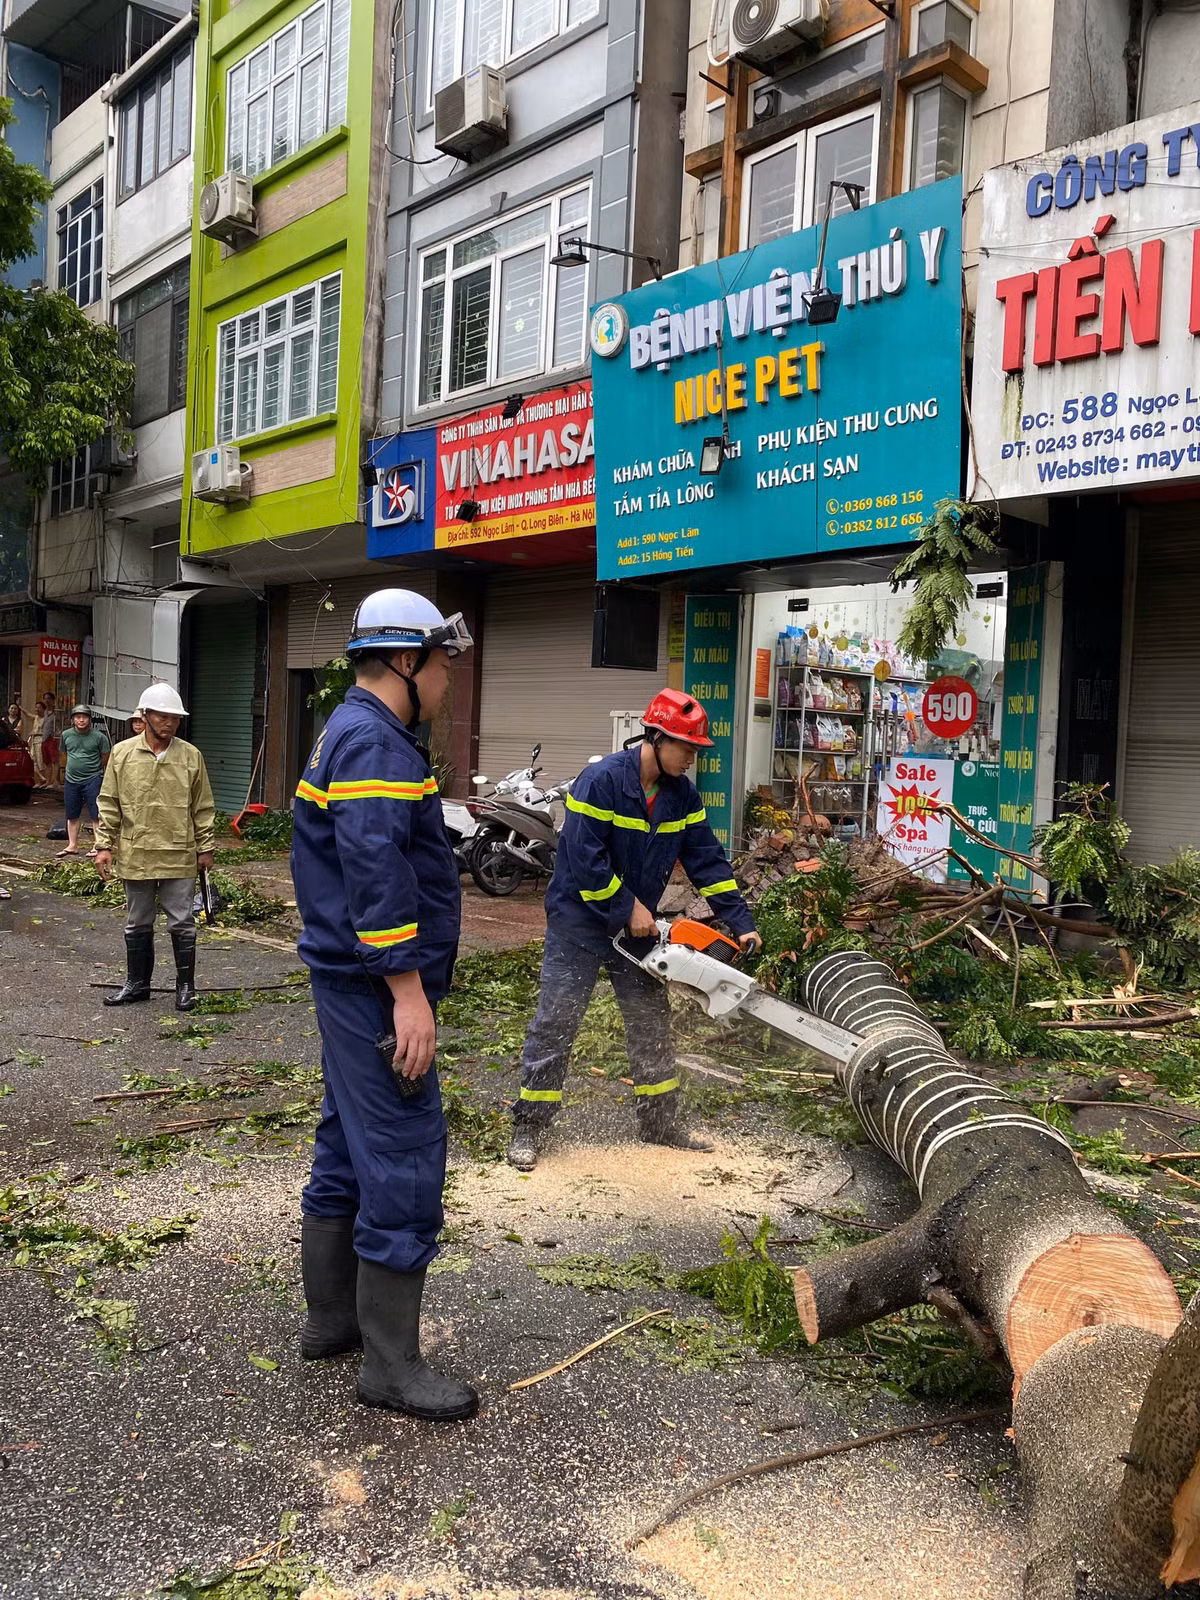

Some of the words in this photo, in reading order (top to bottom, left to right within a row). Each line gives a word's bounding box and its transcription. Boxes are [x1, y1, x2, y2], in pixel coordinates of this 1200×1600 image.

[1026, 142, 1148, 218] CÔNG
[630, 302, 722, 371] BỆNH
[726, 267, 827, 340] VIỆN
[838, 227, 907, 307] THỦ
[919, 226, 946, 284] Y
[996, 214, 1165, 374] TIẾN
[674, 363, 747, 425] NICE
[755, 341, 825, 404] PET
[441, 426, 457, 445] CÔNG
[458, 426, 466, 440] TY
[467, 420, 484, 438] TNHH
[485, 412, 498, 434] SẢN
[525, 402, 553, 423] THƯƠNG
[555, 398, 570, 417] MẠI
[1021, 412, 1054, 431] ĐC:
[1061, 391, 1118, 424] 588
[1128, 394, 1180, 415] Ngọc
[757, 429, 791, 453] PHỤ
[796, 418, 837, 447] KIỆN
[842, 411, 879, 437] THU
[884, 397, 939, 428] CƯNG
[1001, 441, 1031, 460] ĐT:
[1035, 434, 1077, 455] 0243
[1081, 427, 1125, 448] 8734
[1130, 421, 1166, 441] 662
[613, 459, 653, 485] KHÁM
[658, 449, 695, 475] CHỮA
[756, 461, 815, 490] KHÁCH
[823, 453, 859, 481] SẠN
[491, 494, 506, 515] KIỆN
[507, 494, 523, 510] INOX
[524, 488, 547, 507] PHÒNG
[549, 481, 564, 502] TẮM
[566, 478, 581, 499] NHÀ
[613, 491, 643, 517] TẮM
[648, 486, 671, 511] TỈA
[677, 481, 715, 505] LÔNG
[875, 494, 898, 509] 868
[901, 489, 923, 505] 156
[470, 527, 482, 538] 592
[483, 526, 500, 539] Ngọc
[501, 523, 514, 534] Lâm
[549, 514, 563, 526] Biên
[571, 510, 580, 523] Hà
[875, 516, 898, 530] 812
[901, 512, 923, 527] 686
[642, 533, 656, 545] 590
[658, 531, 679, 543] Ngọc
[641, 552, 651, 563] 15
[675, 545, 694, 558] Tiến
[717, 612, 731, 631] TRỊ
[385, 629, 416, 637] GENTOS
[43, 640, 60, 650] NHÀ
[61, 641, 78, 652] MAY
[693, 648, 706, 663] XN
[708, 645, 729, 663] MÁU
[41, 653, 78, 669] UYÊN
[691, 681, 711, 699] SIÊU
[713, 681, 728, 699] ÂM
[927, 692, 972, 722] 590
[712, 716, 731, 737] SẢN
[1004, 750, 1016, 773] PHỤ
[1018, 747, 1033, 774] KIỆN
[896, 763, 937, 782] Sale
[896, 796, 932, 816] 10%
[968, 805, 988, 816] TRỰC
[895, 824, 927, 842] Spa
[903, 843, 922, 854] hàng
